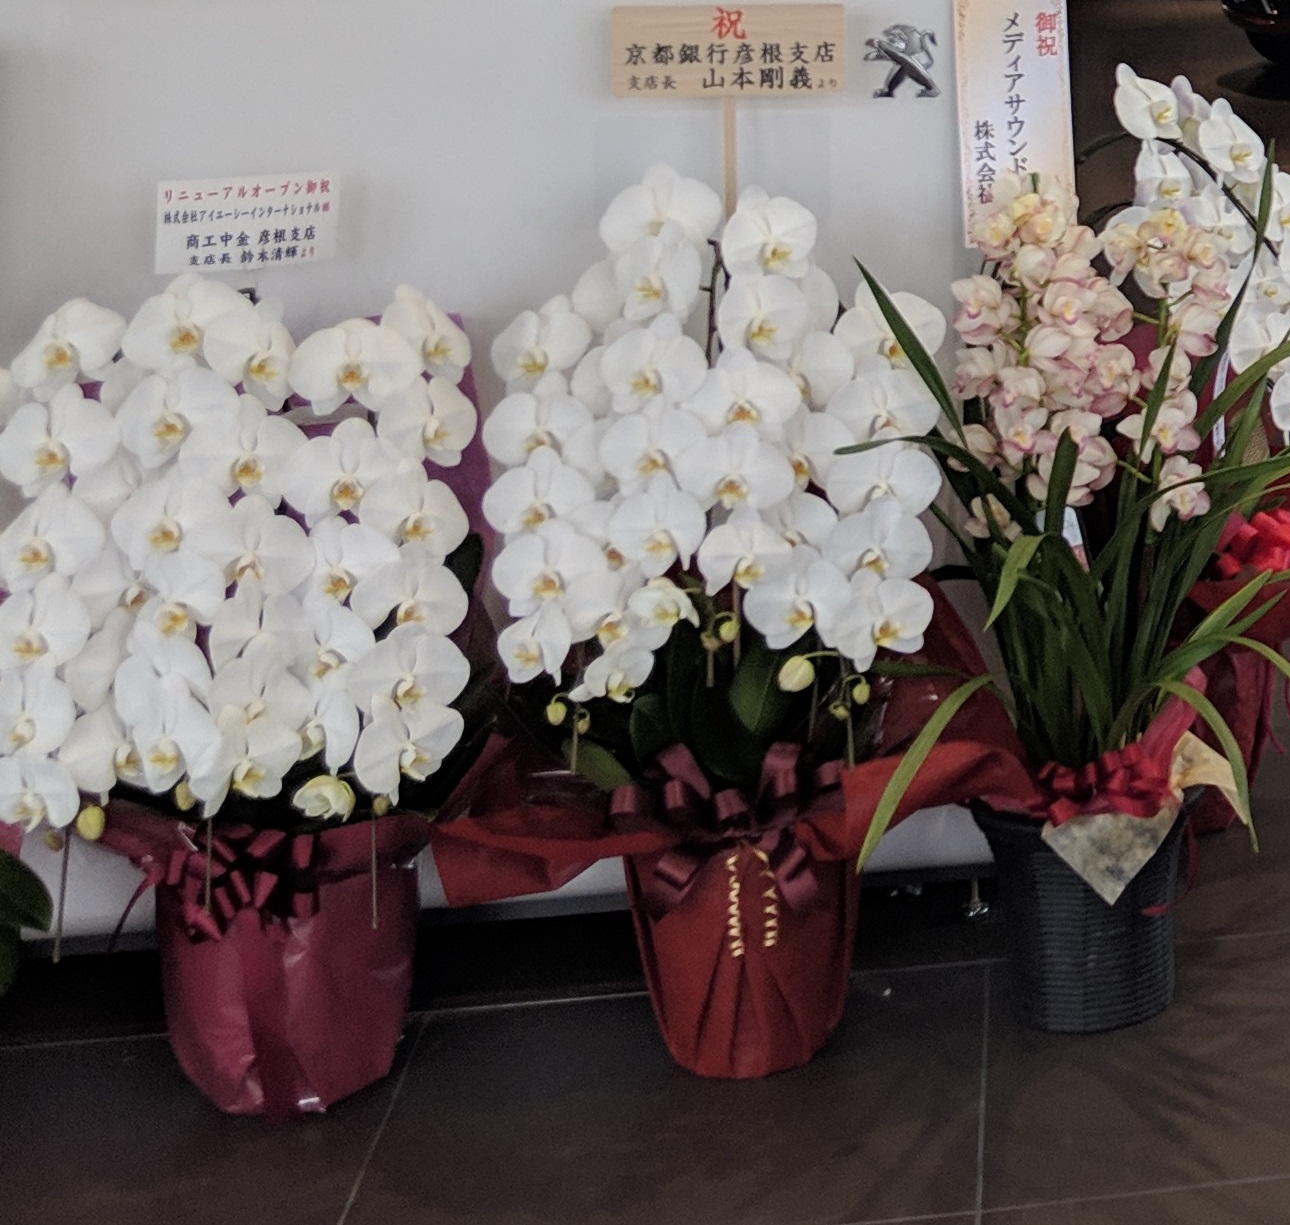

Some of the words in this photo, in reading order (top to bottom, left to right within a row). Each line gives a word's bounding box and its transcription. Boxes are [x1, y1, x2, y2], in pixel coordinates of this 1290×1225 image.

[711, 7, 747, 40] 祝
[1035, 12, 1059, 57] 御祝
[624, 41, 837, 66] 京都銀行彦根支店
[1002, 11, 1029, 175] メディアサウンド
